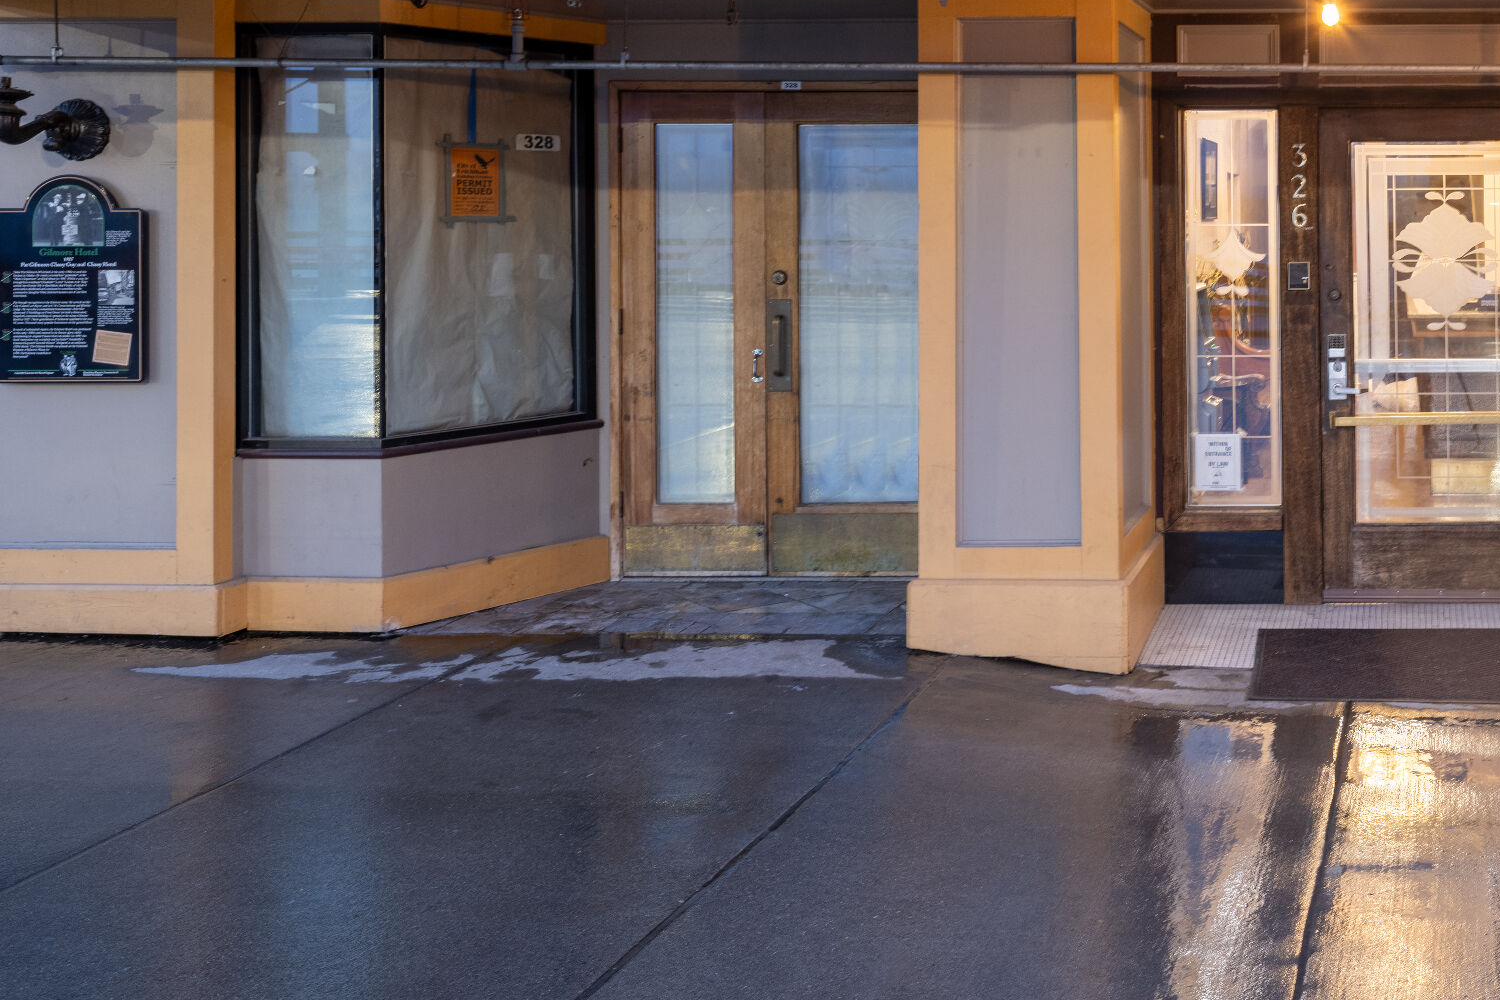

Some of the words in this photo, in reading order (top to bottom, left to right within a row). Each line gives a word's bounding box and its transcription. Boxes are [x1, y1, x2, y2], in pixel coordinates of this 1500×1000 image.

[523, 135, 554, 149] 328
[456, 187, 493, 195] ISSUED
[1291, 144, 1308, 227] 326
[39, 248, 74, 256] Gilmore
[75, 248, 98, 256] Hotel
